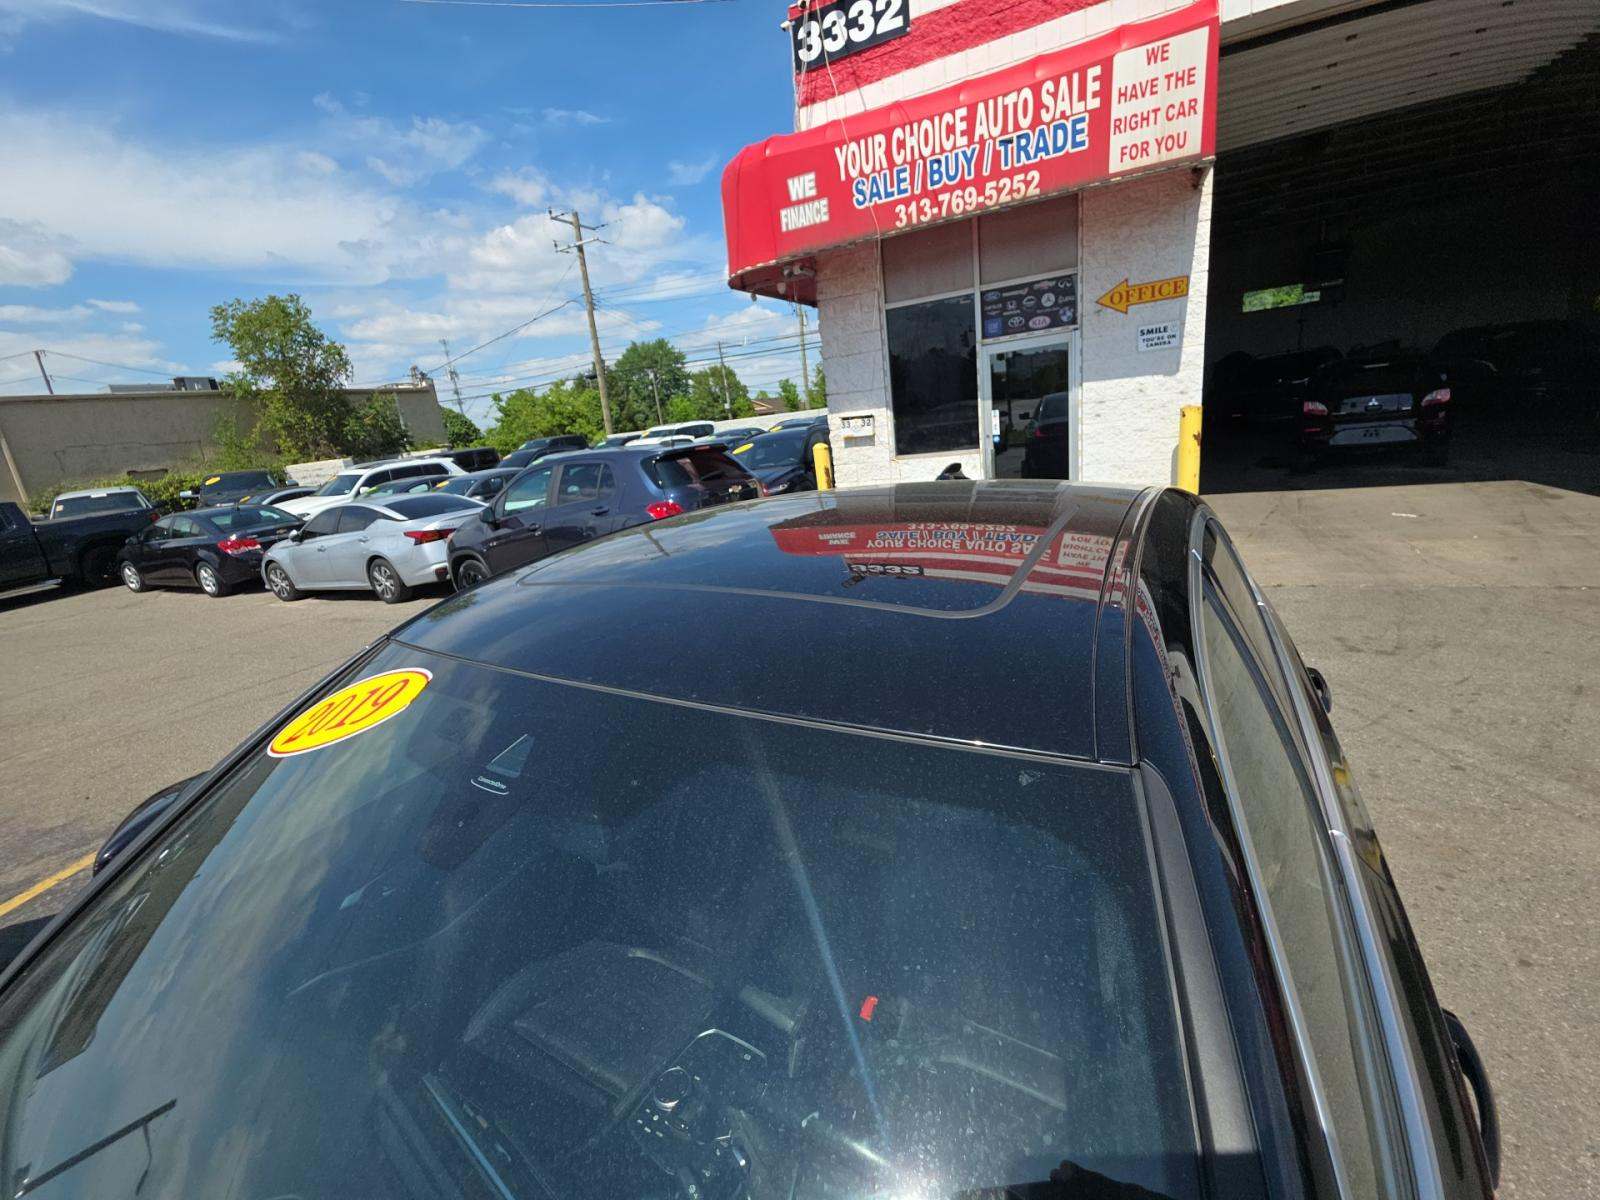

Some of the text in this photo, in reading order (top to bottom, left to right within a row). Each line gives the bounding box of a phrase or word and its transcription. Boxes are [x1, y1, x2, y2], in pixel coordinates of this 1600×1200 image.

[797, 0, 904, 62] 3332
[1146, 43, 1170, 66] WE
[1118, 67, 1196, 104] HAVE THE
[834, 65, 1101, 181] YOUR CHOICE AUTO SALE
[1113, 98, 1198, 135] RIGHT CAR
[853, 165, 910, 208] SALE
[927, 144, 979, 190] BUY
[996, 113, 1089, 171] TRADE
[1120, 131, 1187, 163] FOR YOU
[787, 172, 817, 201] WE
[895, 170, 1040, 228] 313-769-5252
[780, 197, 829, 232] FINANCE
[1110, 280, 1185, 305] OFFICE
[1139, 325, 1169, 337] SMILE
[1142, 335, 1164, 343] YOU'RE
[1146, 340, 1172, 348] CAMERA
[841, 419, 872, 429] 33 32
[281, 678, 410, 746] 2019
